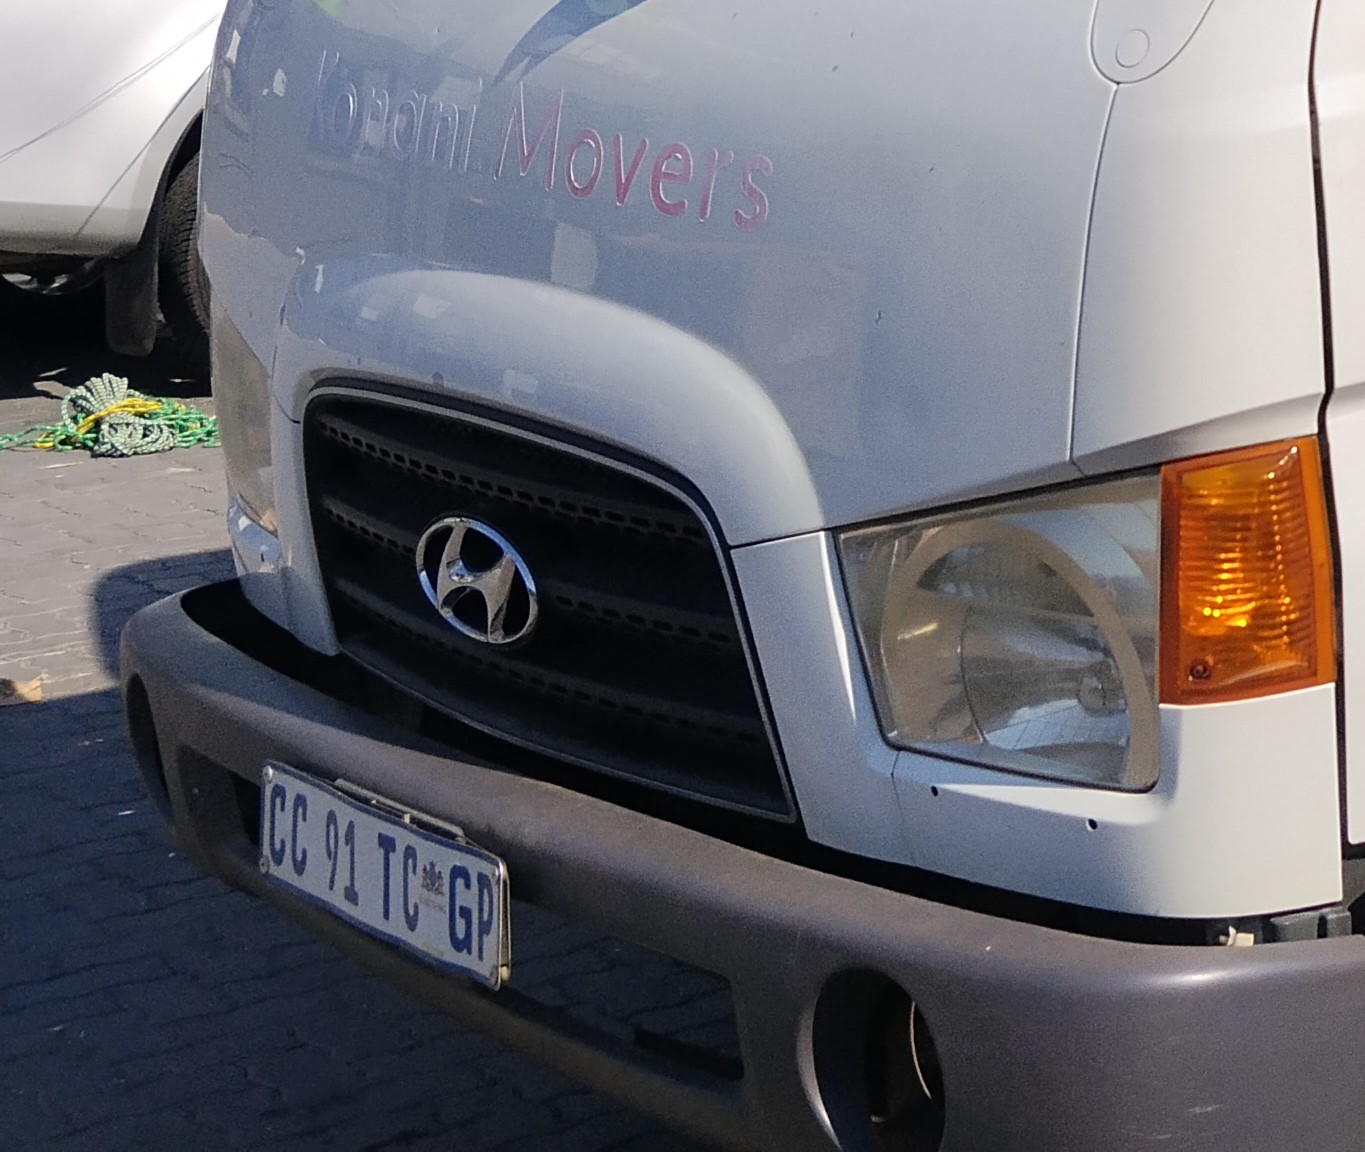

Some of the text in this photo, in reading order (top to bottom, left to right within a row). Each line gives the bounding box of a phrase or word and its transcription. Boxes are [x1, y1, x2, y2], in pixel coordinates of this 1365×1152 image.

[494, 81, 773, 232] Movers
[269, 783, 494, 961] CC 91 TC GP
